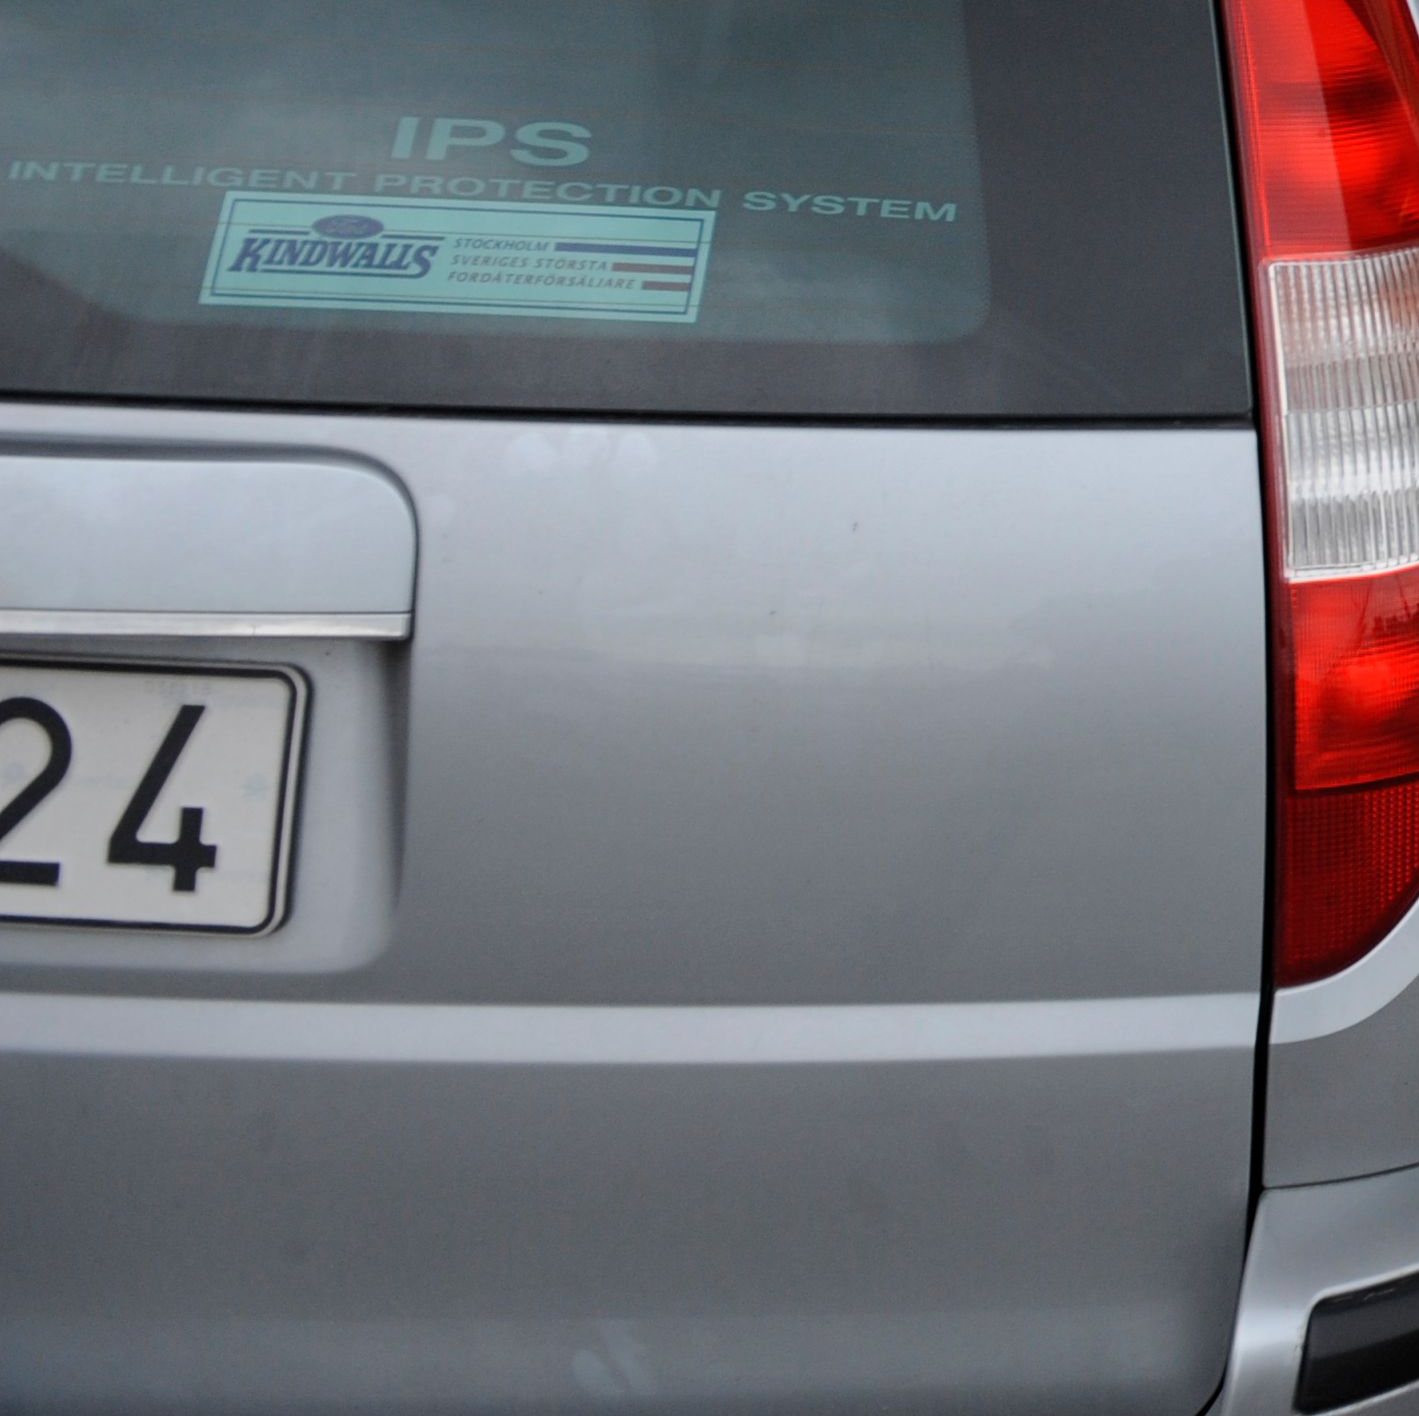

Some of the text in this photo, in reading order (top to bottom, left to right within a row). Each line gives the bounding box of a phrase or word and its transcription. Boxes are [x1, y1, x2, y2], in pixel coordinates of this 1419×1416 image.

[390, 115, 592, 167] IPS
[7, 160, 958, 222] INTELLIGENT PROTECTION SYSTEM
[228, 237, 440, 279] KINDWALLS
[450, 254, 529, 269] SVERIGES
[454, 237, 551, 252] STOCKHOLM
[0, 696, 217, 892] 24
